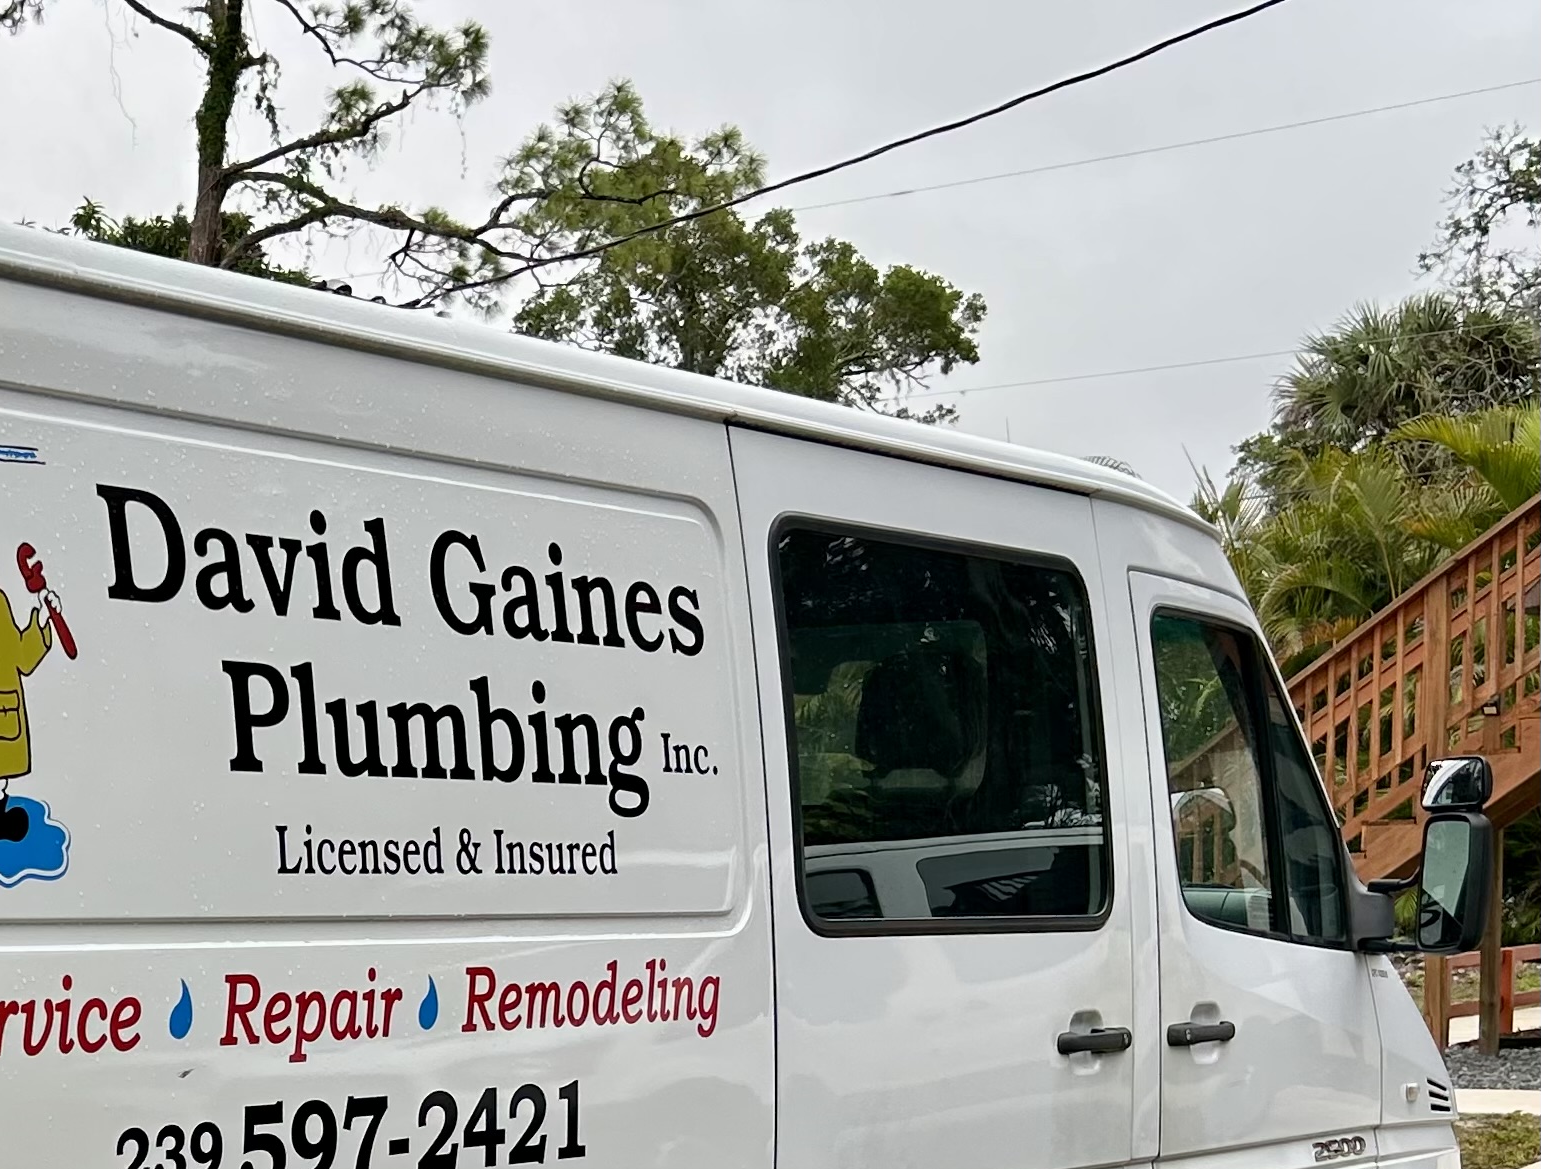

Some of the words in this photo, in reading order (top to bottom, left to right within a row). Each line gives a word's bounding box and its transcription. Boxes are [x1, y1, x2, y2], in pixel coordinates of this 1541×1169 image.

[96, 483, 401, 627] David
[430, 530, 704, 656] Gaines
[222, 660, 649, 817] Plumbing
[661, 733, 718, 775] Inc.
[275, 824, 444, 875] Licensed
[456, 828, 482, 875] &
[493, 829, 618, 875] Insured
[220, 968, 403, 1063] Repair
[462, 959, 720, 1037] Remodeling
[1311, 1135, 1366, 1162] 2500
